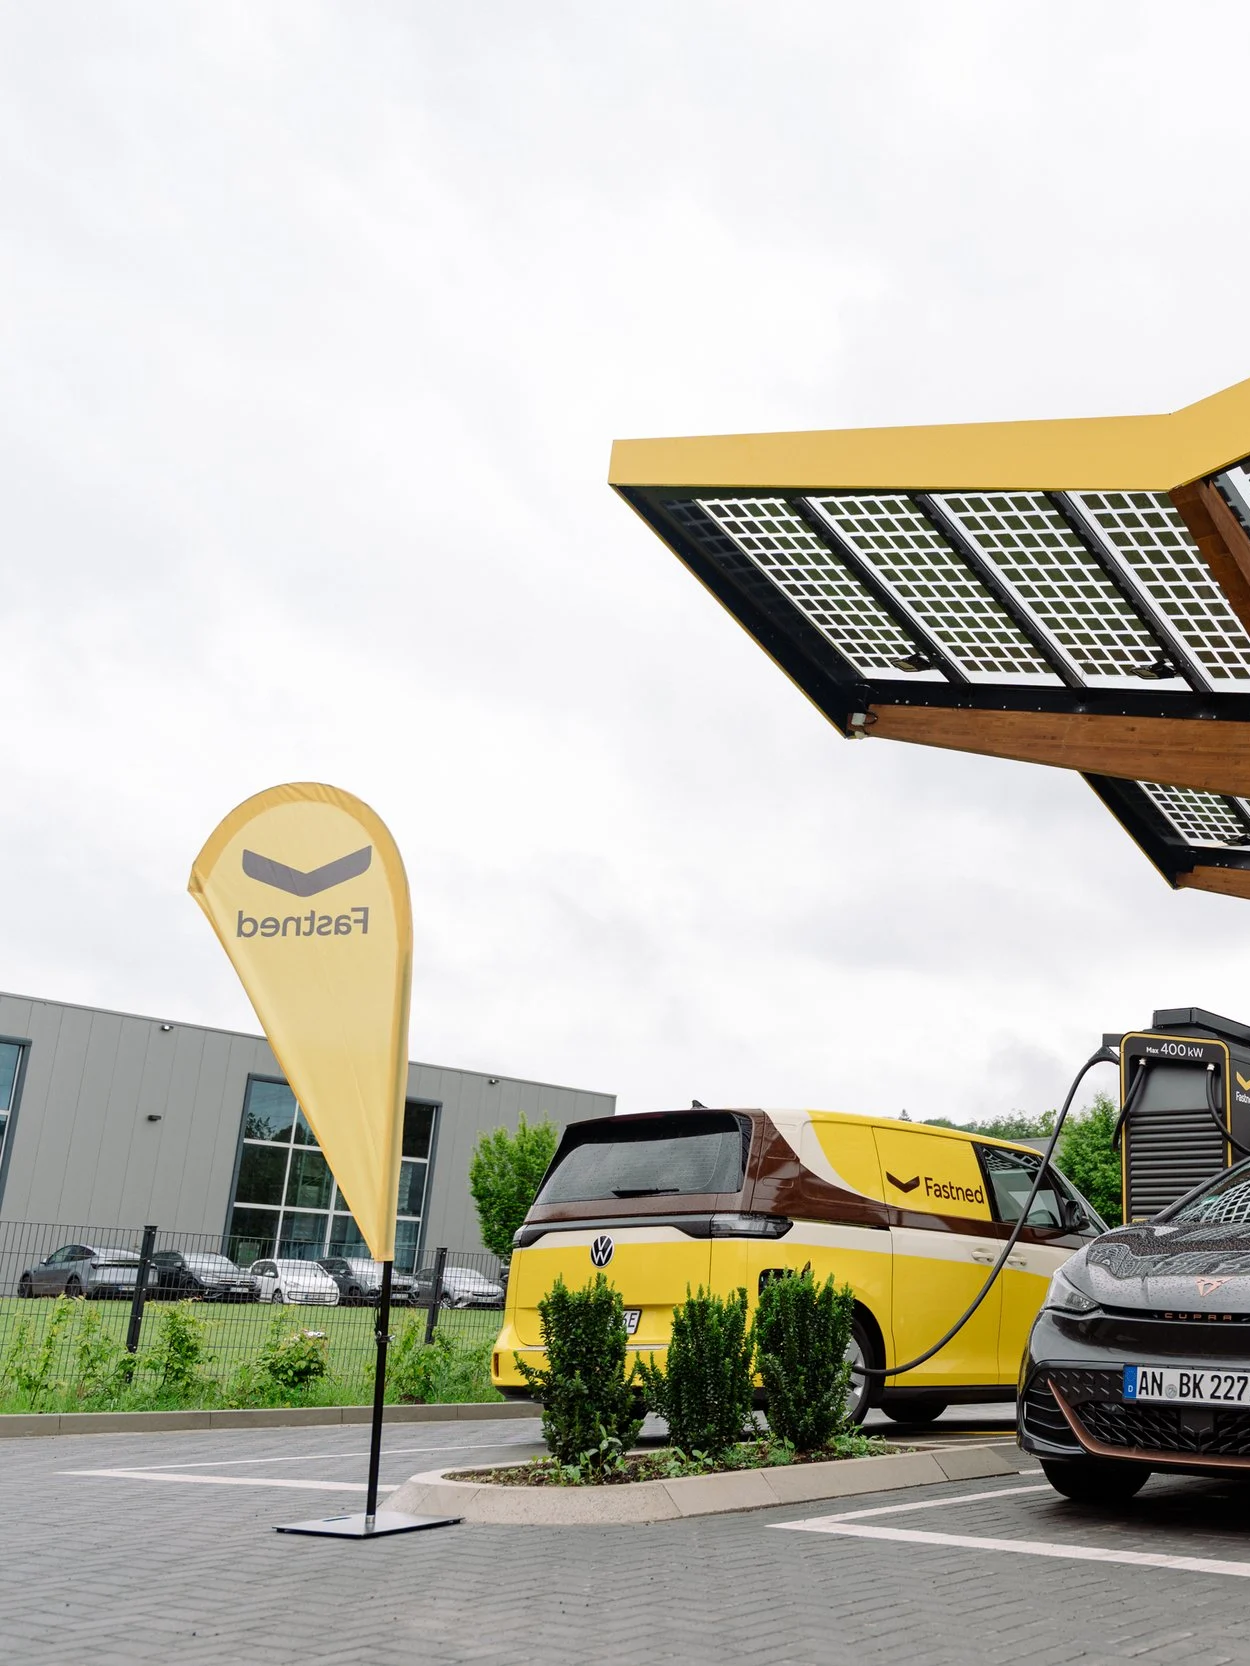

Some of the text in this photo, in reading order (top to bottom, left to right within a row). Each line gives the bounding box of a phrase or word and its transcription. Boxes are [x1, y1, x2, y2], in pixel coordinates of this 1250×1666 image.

[1146, 1043, 1204, 1058] Max 400 kW
[924, 1176, 985, 1204] Fastned
[1164, 1312, 1233, 1321] CUPRA
[1127, 1384, 1134, 1393] D
[1138, 1370, 1164, 1397] AN
[1179, 1372, 1205, 1399] BK
